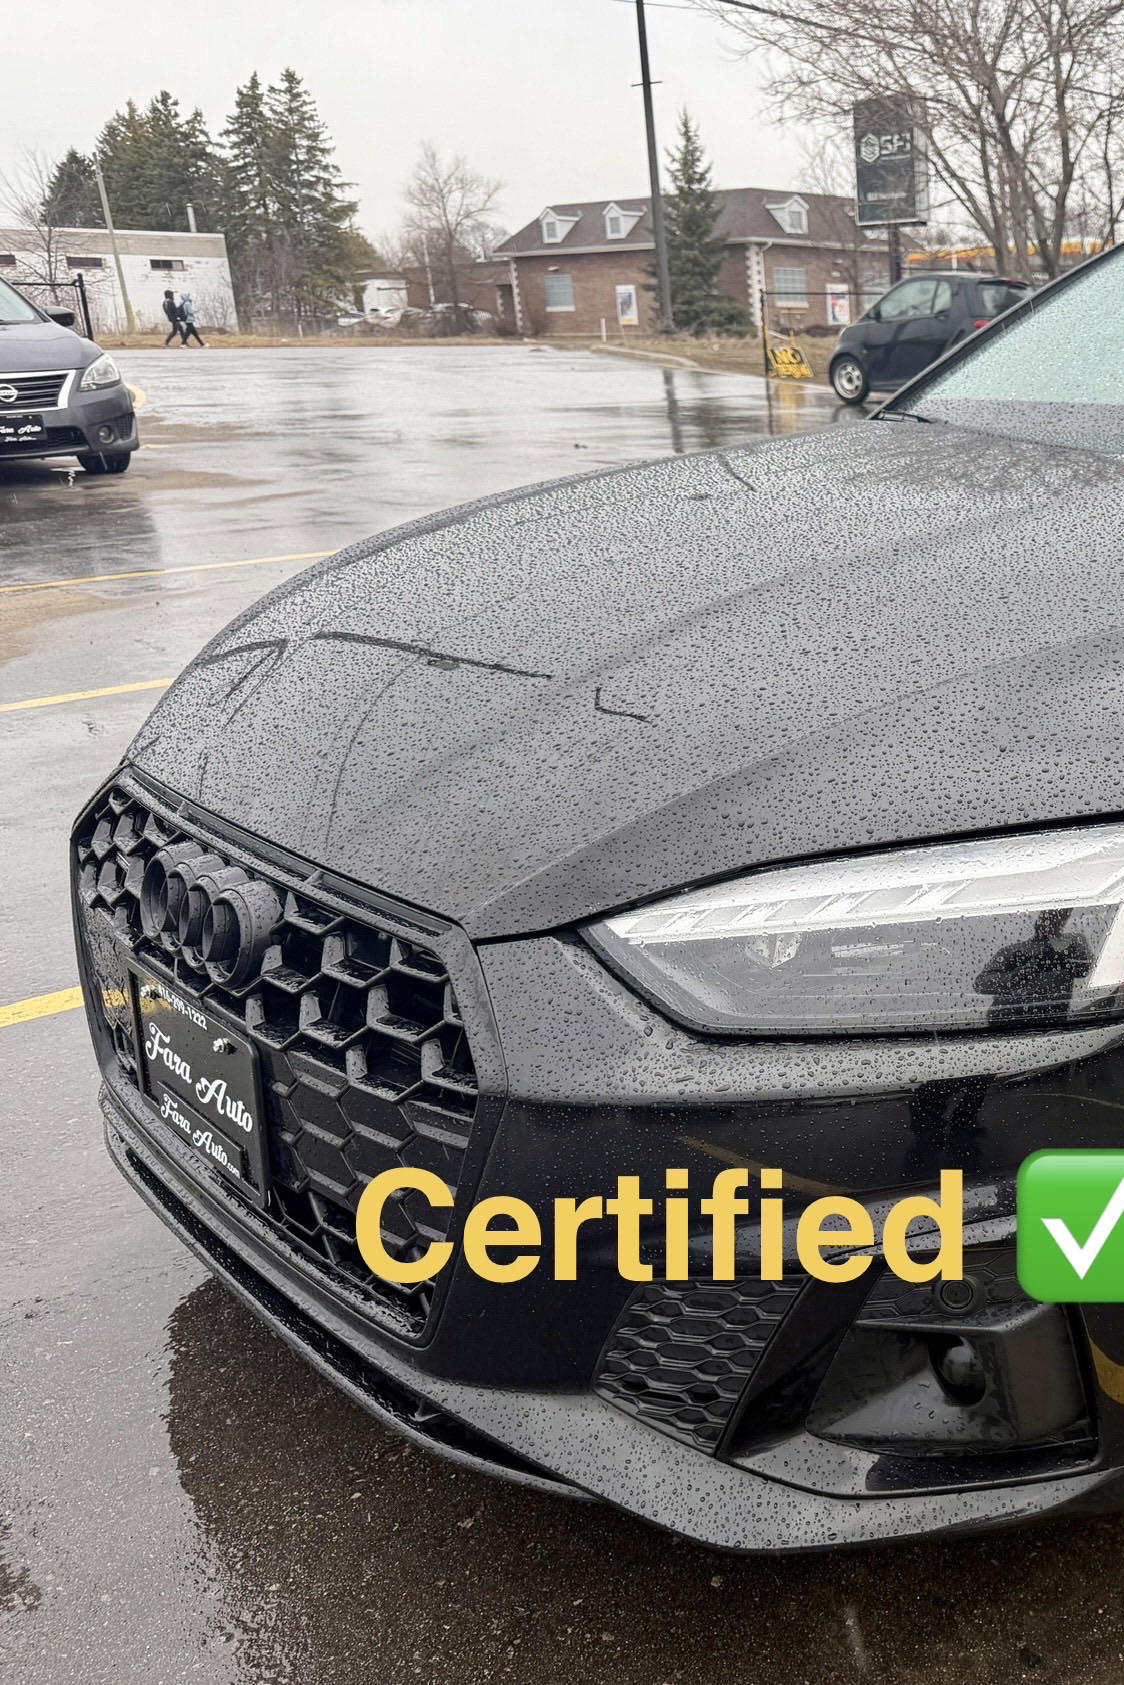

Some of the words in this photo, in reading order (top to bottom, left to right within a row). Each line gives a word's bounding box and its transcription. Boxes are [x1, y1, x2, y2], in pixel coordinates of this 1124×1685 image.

[158, 984, 207, 1030] 416-299-1222
[146, 1022, 192, 1084] Fara
[196, 1077, 253, 1133] Auto
[161, 1093, 191, 1134] Fara
